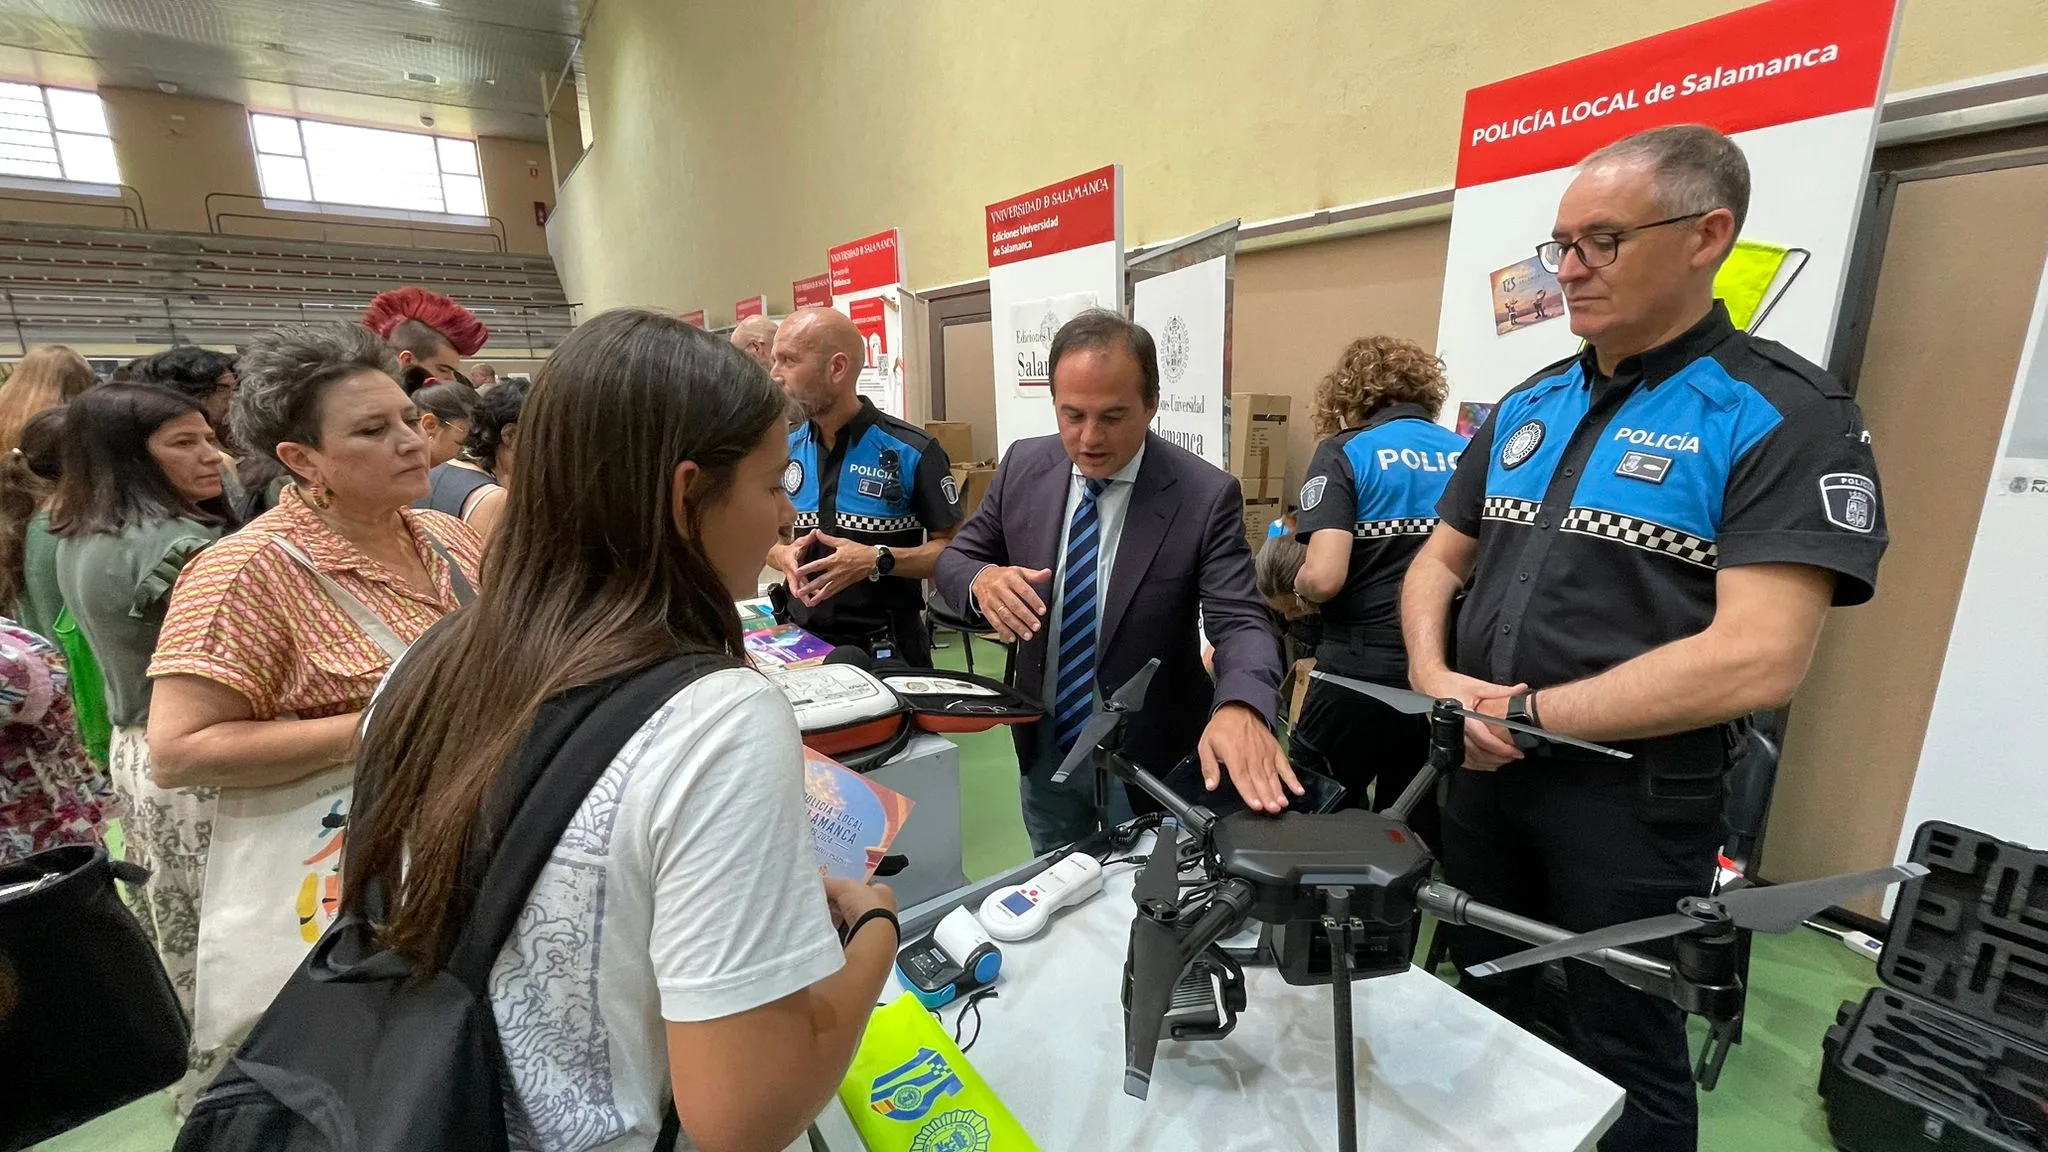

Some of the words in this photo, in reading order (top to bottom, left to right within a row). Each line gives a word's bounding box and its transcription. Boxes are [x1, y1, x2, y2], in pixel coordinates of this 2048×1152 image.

[1471, 108, 1557, 147] POLICÍA
[1560, 89, 1640, 125] LOCAL
[1644, 81, 1675, 106] de
[1680, 43, 1839, 97] Salamanca
[1051, 178, 1109, 206] SALAMANCA
[992, 228, 1020, 243] Ediciones
[1020, 215, 1059, 236] Universidad
[993, 245, 1000, 257] de
[1000, 240, 1033, 255] Salamanca
[1170, 394, 1205, 414] Universidad
[1614, 427, 1700, 453] POLICÍA
[808, 810, 857, 844] AMANCA
[837, 812, 864, 832] LOCAL
